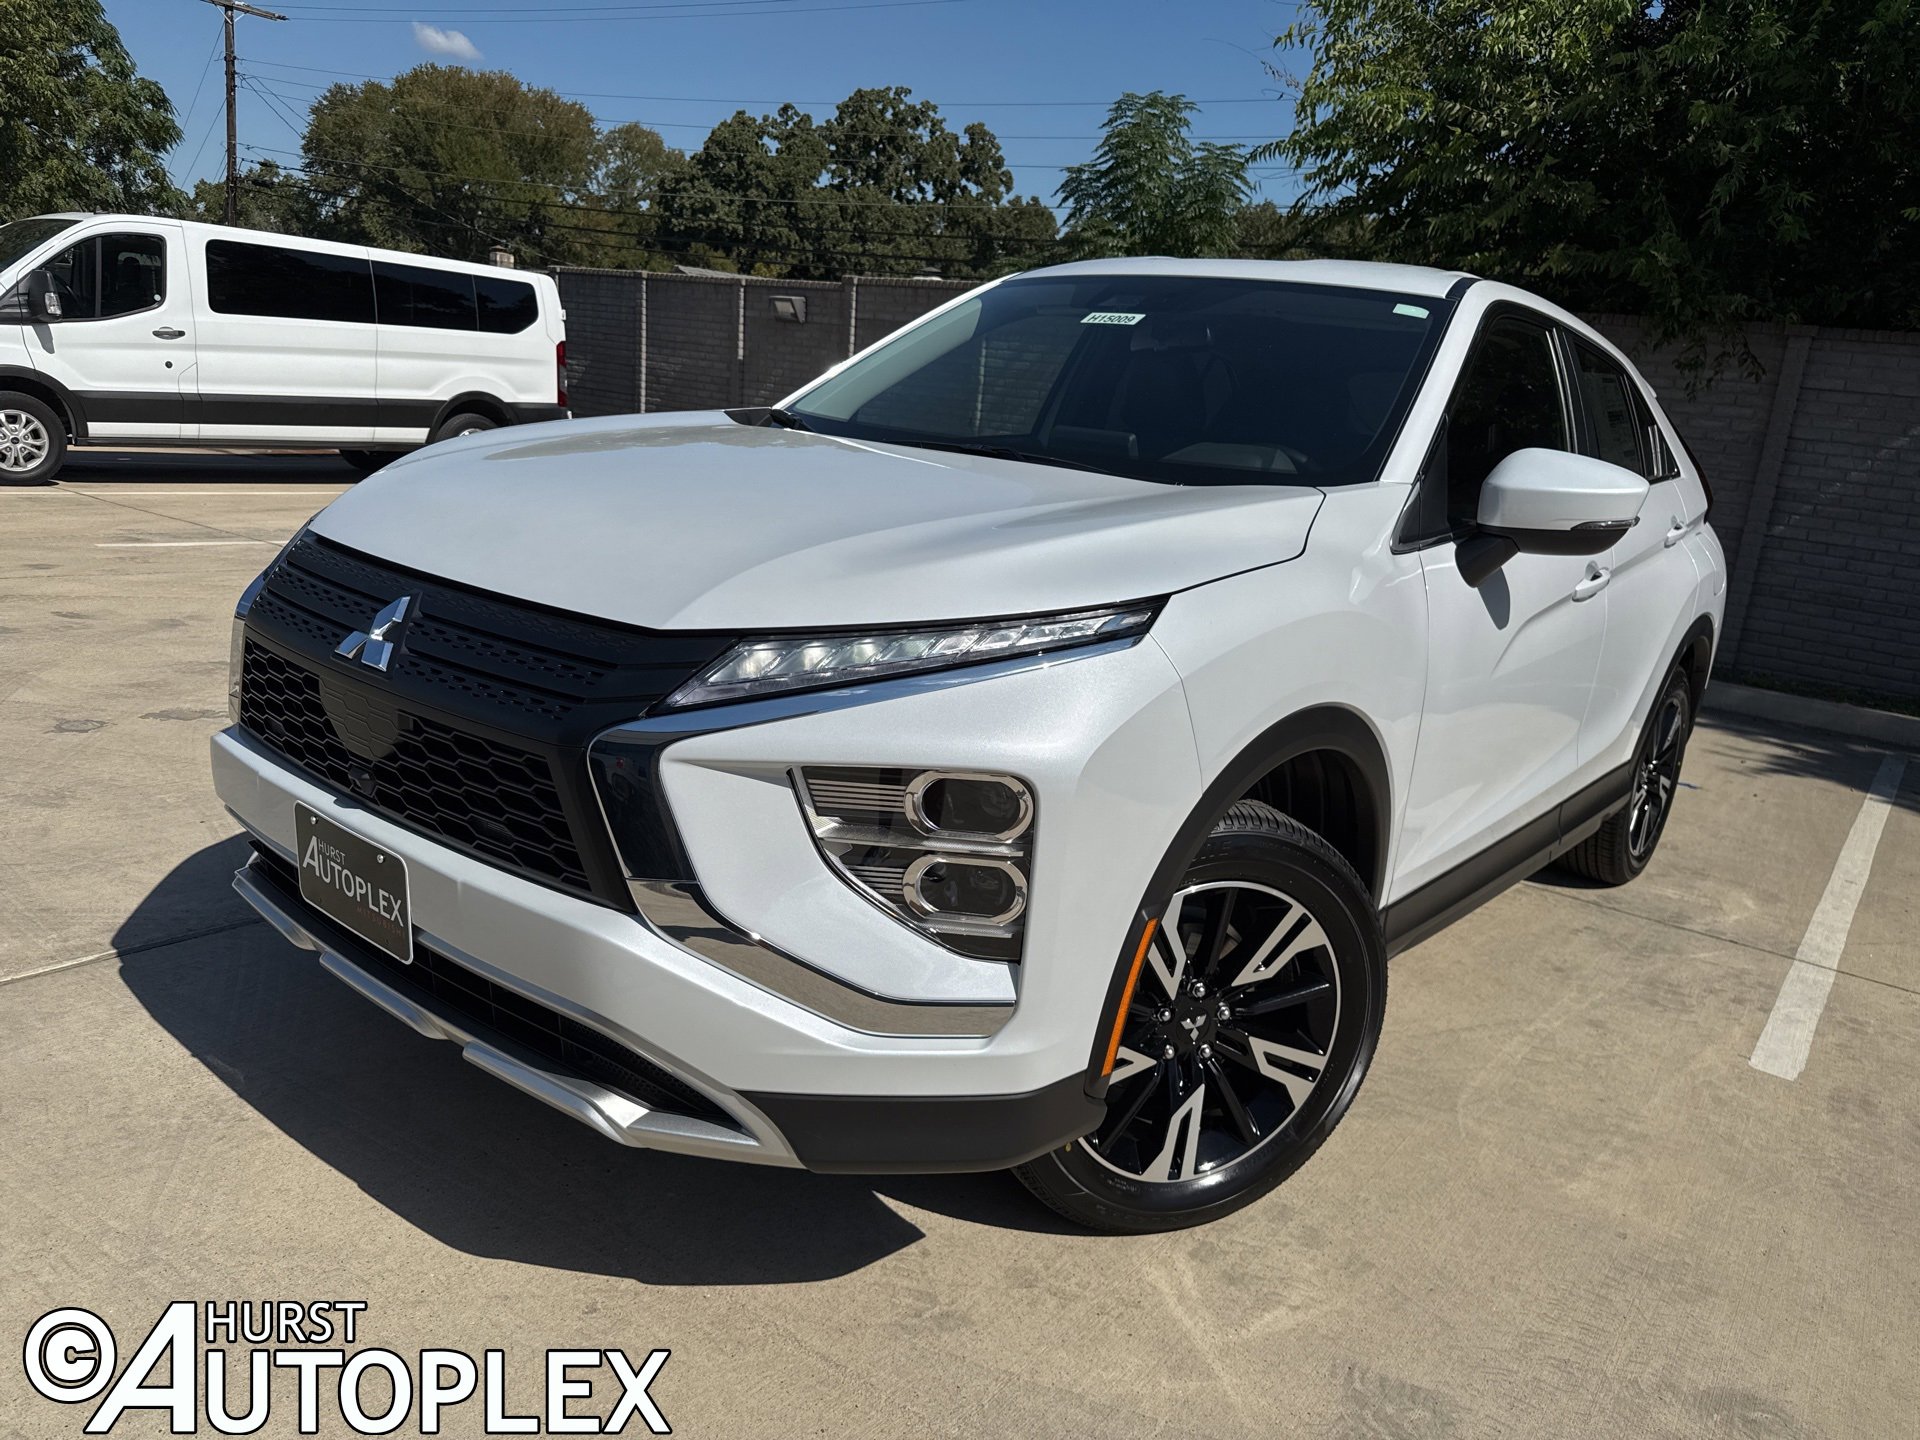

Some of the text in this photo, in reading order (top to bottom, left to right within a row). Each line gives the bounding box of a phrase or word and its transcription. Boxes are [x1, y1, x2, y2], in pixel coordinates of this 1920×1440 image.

[1087, 314, 1136, 323] H15009
[318, 840, 345, 864] HURST
[303, 836, 404, 927] AUTOPLEX
